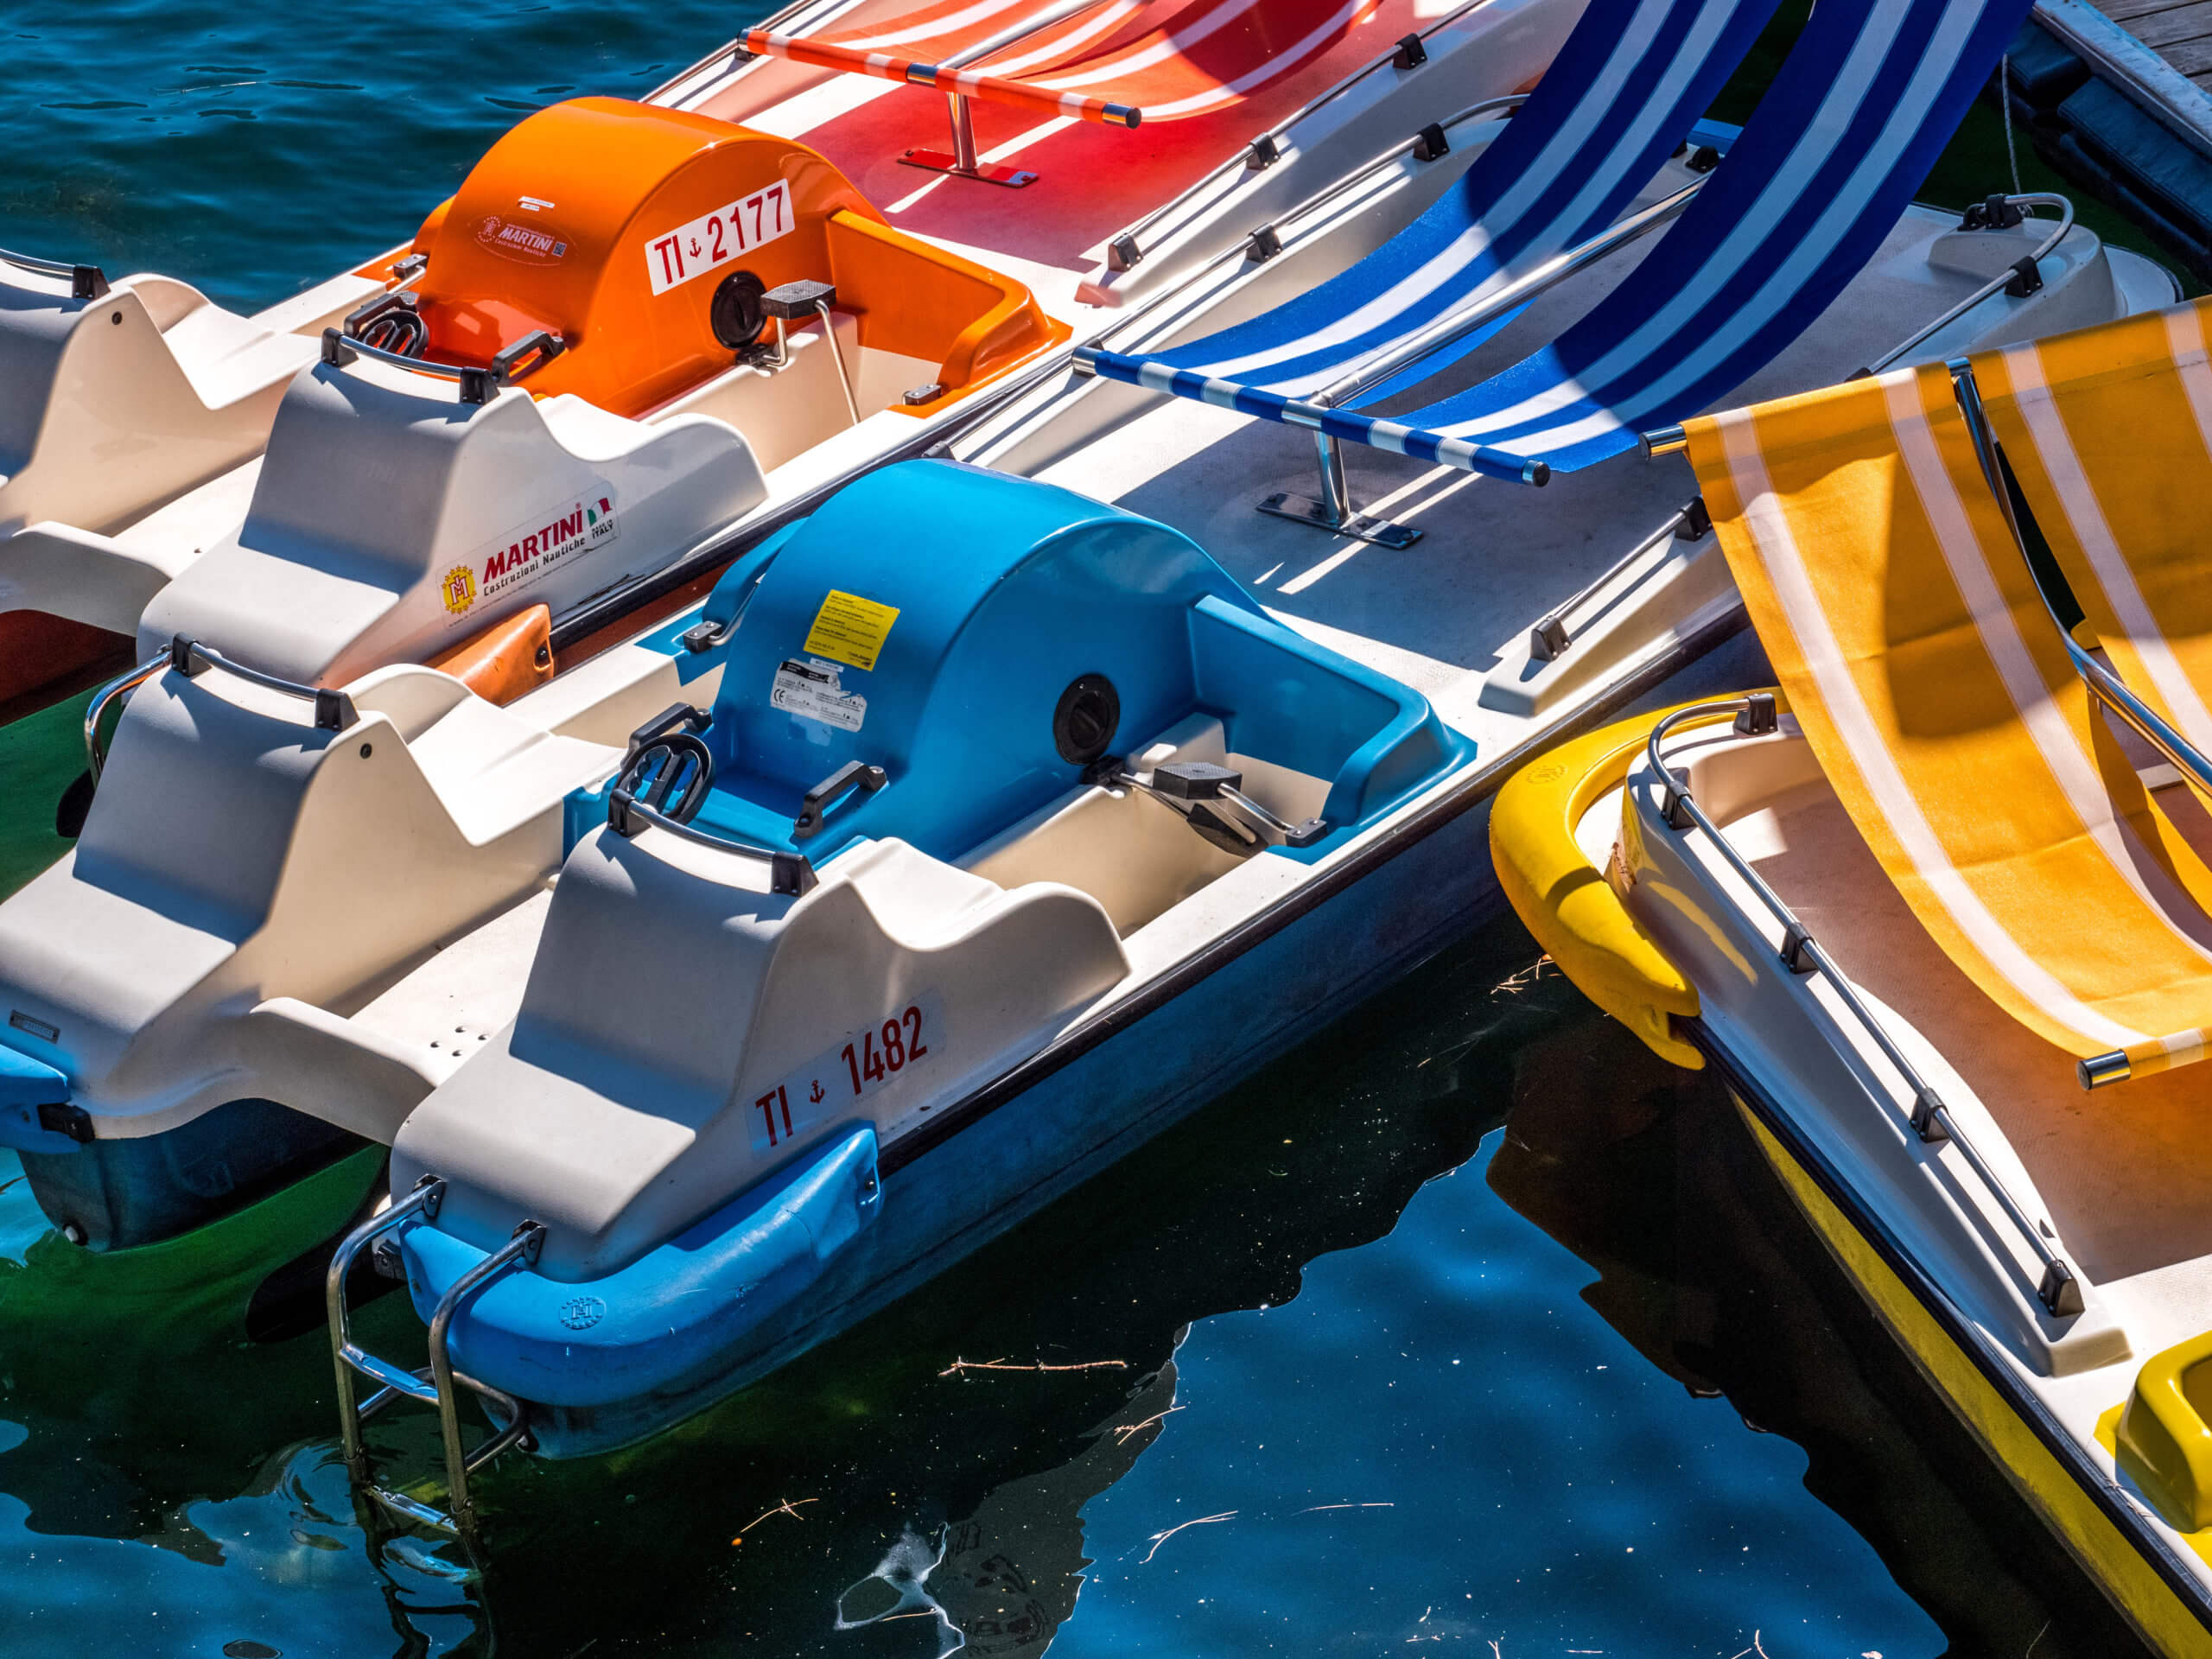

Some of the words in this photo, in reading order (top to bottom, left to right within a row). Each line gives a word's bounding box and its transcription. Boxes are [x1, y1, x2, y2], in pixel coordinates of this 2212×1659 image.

[499, 226, 554, 251] MARTINI
[654, 234, 685, 284] TI
[707, 186, 784, 263] 2177
[483, 510, 583, 584] MARTINI
[484, 560, 539, 596] Costruzioni
[543, 537, 586, 565] Nautiche
[755, 1084, 793, 1147] TI
[841, 1006, 927, 1096] 1482
